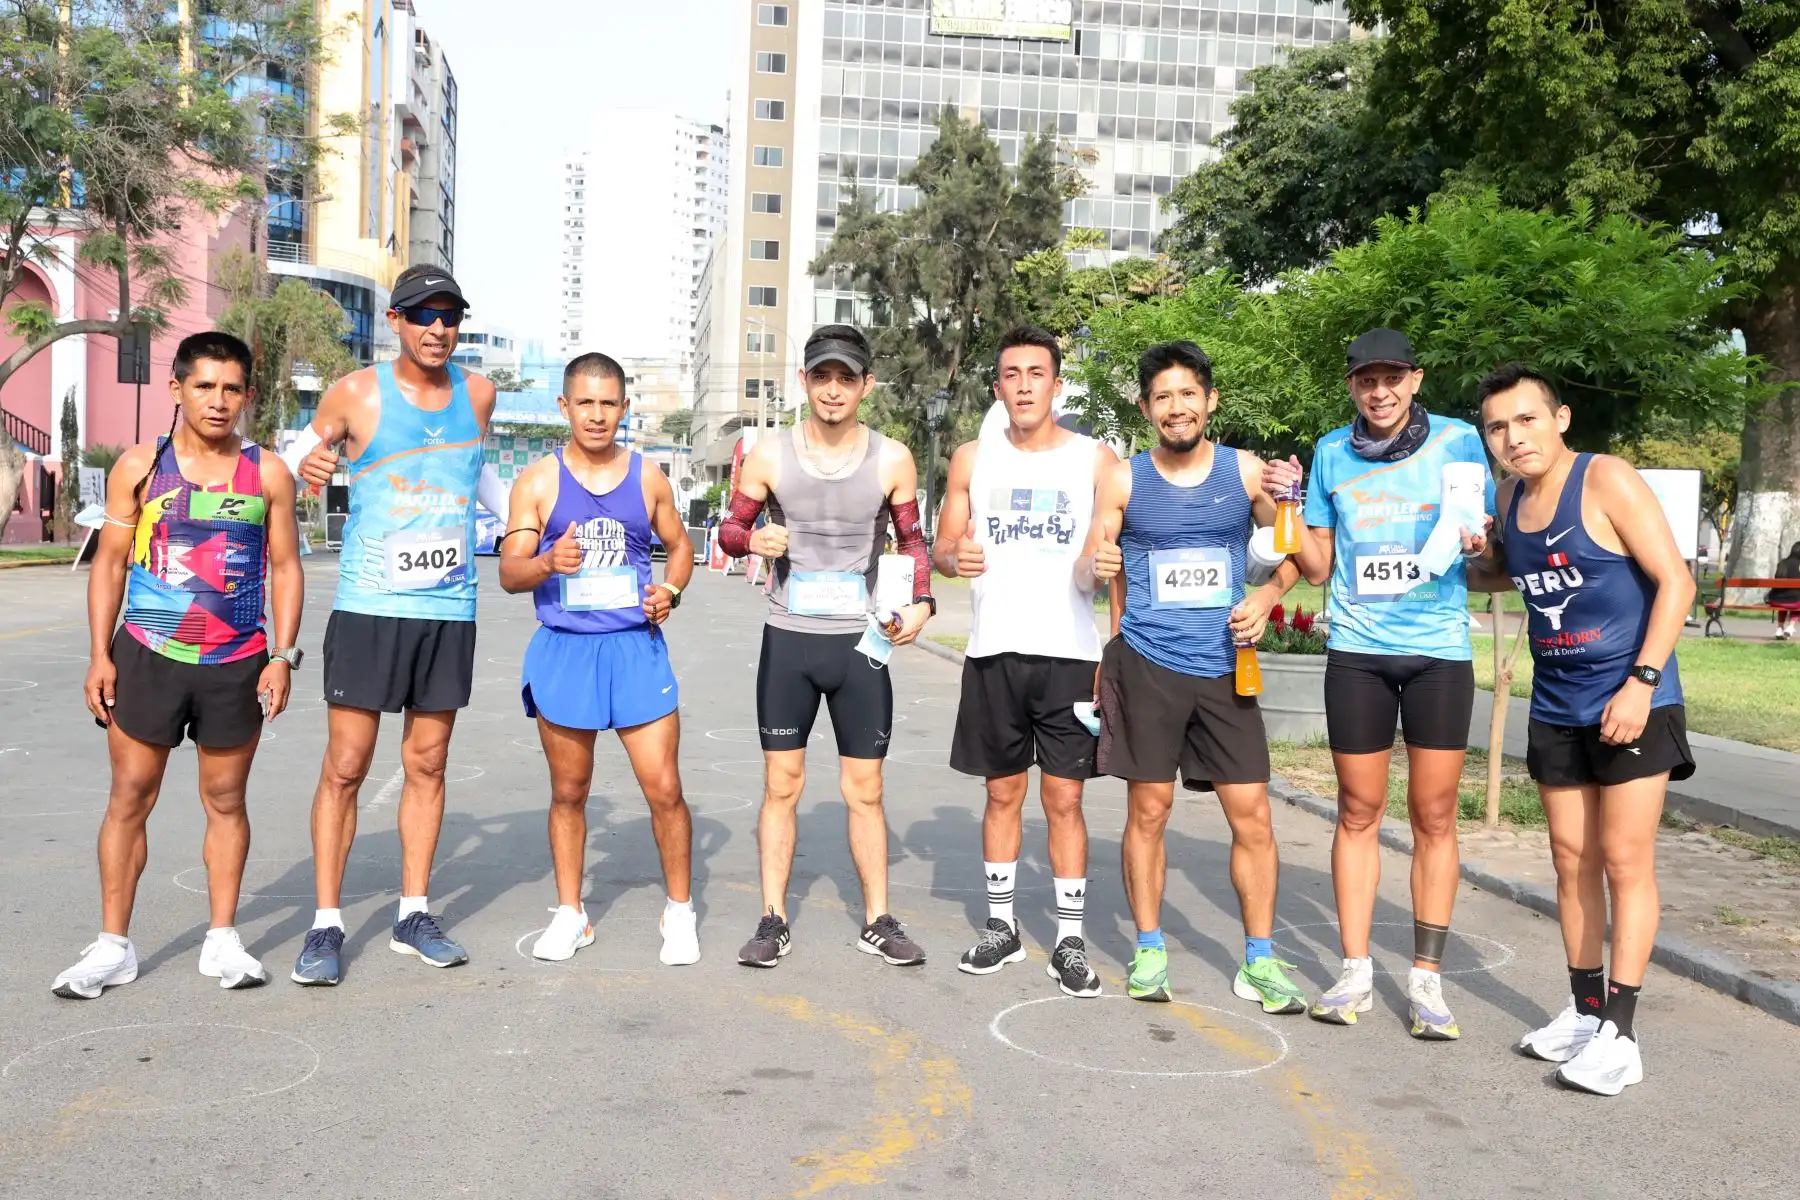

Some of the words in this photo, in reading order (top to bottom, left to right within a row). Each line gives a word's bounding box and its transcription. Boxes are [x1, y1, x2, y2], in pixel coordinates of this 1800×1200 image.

[986, 515, 1044, 545] Punta
[398, 547, 458, 572] 3402
[1165, 567, 1219, 588] 4292
[1363, 560, 1420, 581] 4513
[1554, 648, 1560, 656] &
[1562, 646, 1586, 656] Drinks
